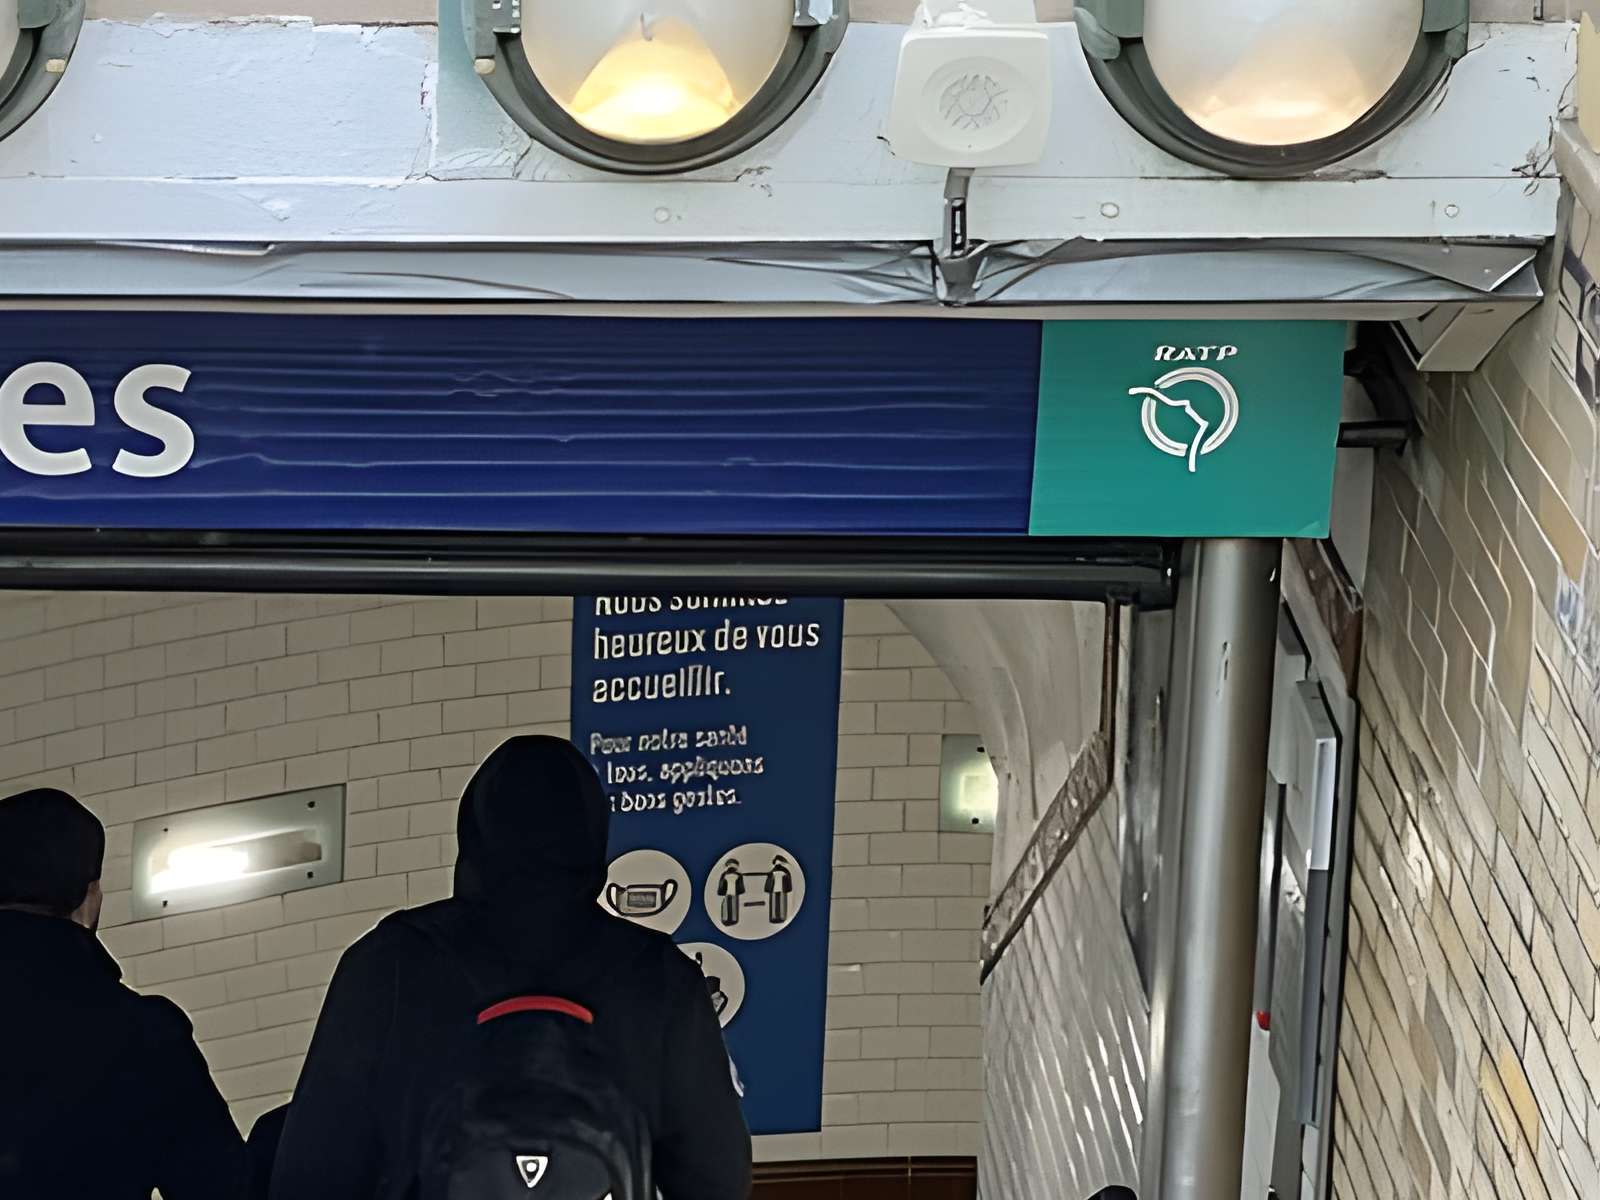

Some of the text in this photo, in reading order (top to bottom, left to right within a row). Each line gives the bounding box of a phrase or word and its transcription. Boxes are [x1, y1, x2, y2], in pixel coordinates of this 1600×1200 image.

[1154, 344, 1238, 361] RATP
[593, 618, 820, 660] heureux de vous
